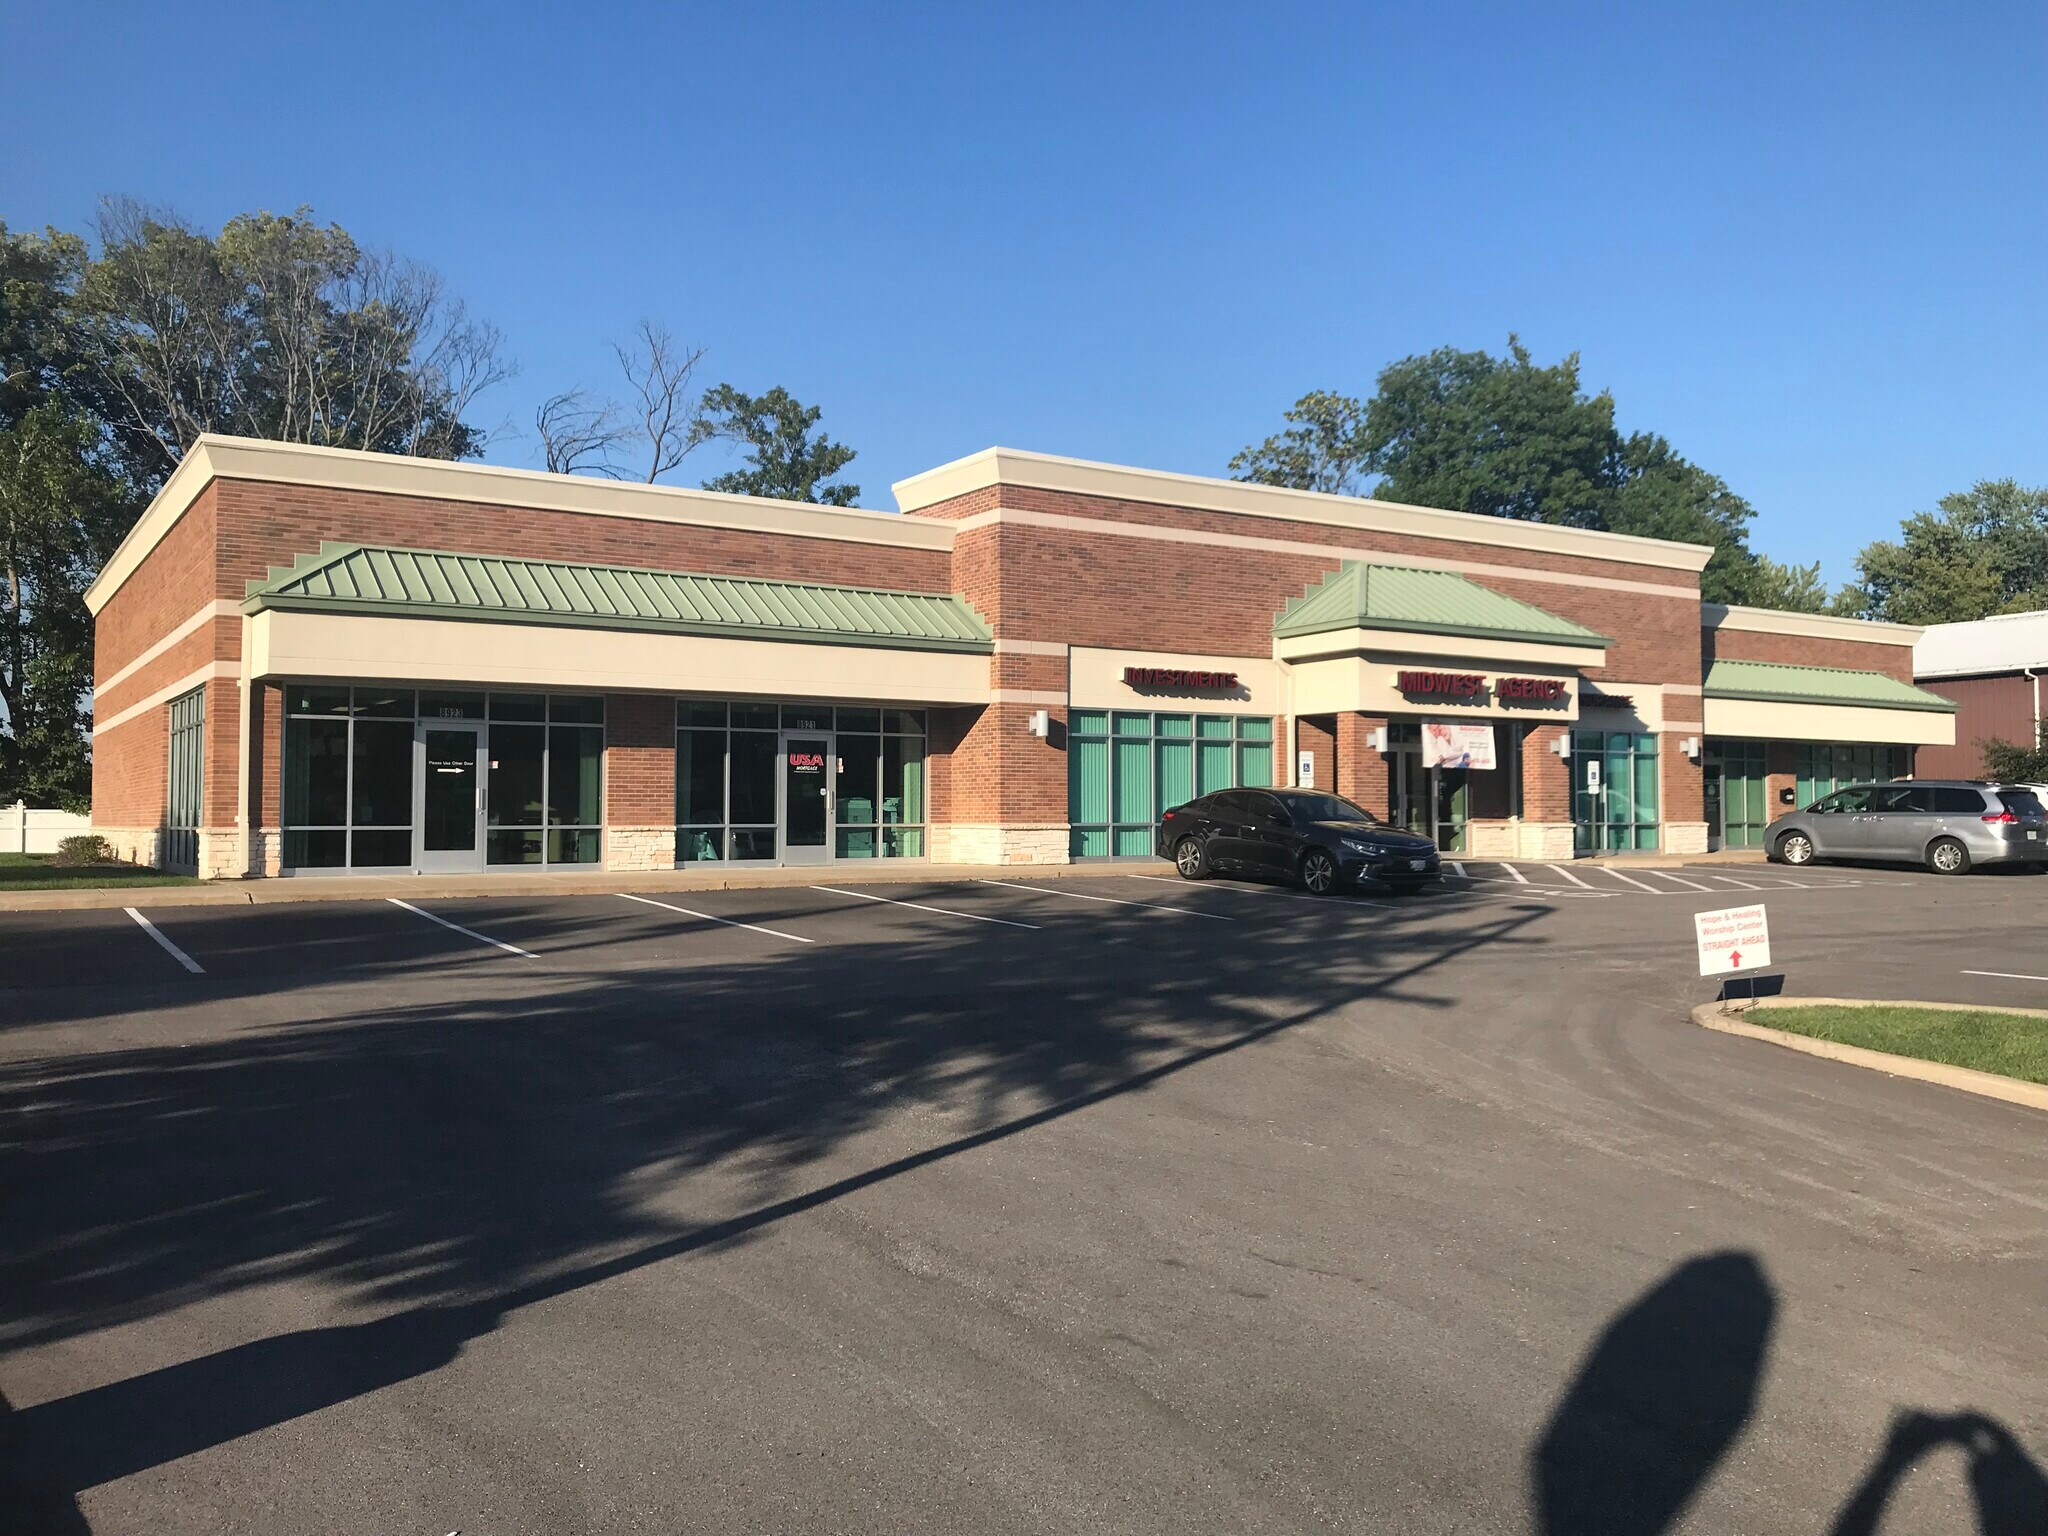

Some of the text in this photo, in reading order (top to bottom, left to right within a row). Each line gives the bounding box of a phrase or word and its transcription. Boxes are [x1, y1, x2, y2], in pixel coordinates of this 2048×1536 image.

[1125, 667, 1239, 689] INVESTMENTS
[1399, 671, 1567, 700] MIDWEST AGENCY
[440, 707, 463, 718] 8923
[790, 753, 824, 765] USA
[1724, 912, 1730, 921] &
[1732, 910, 1761, 918] Healing
[1703, 921, 1763, 935] Worship Center
[1703, 934, 1765, 951] STRAIGHT AHEAD
